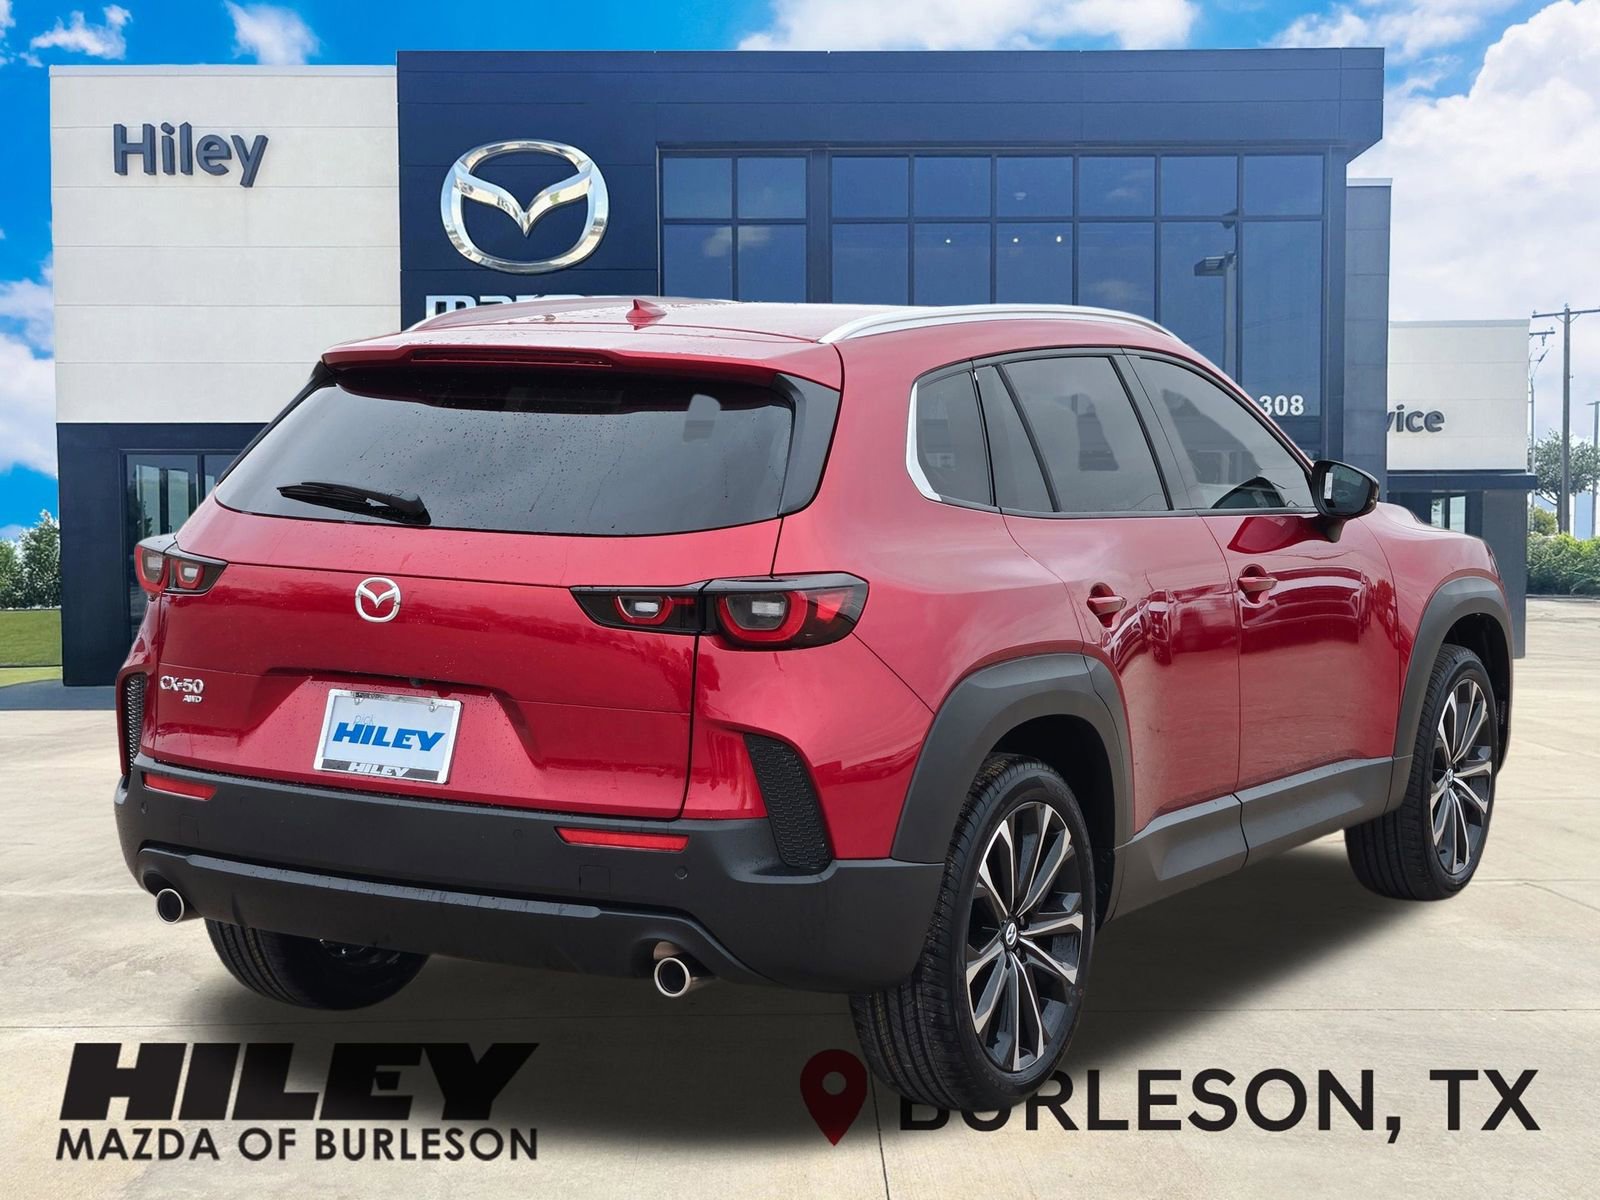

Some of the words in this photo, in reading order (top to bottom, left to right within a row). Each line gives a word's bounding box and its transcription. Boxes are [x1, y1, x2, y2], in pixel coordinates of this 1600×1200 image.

[113, 121, 269, 188] Hiley
[1259, 394, 1304, 416] 308
[160, 675, 204, 694] CX-50
[332, 721, 446, 752] HILEY
[348, 762, 410, 777] HILEY
